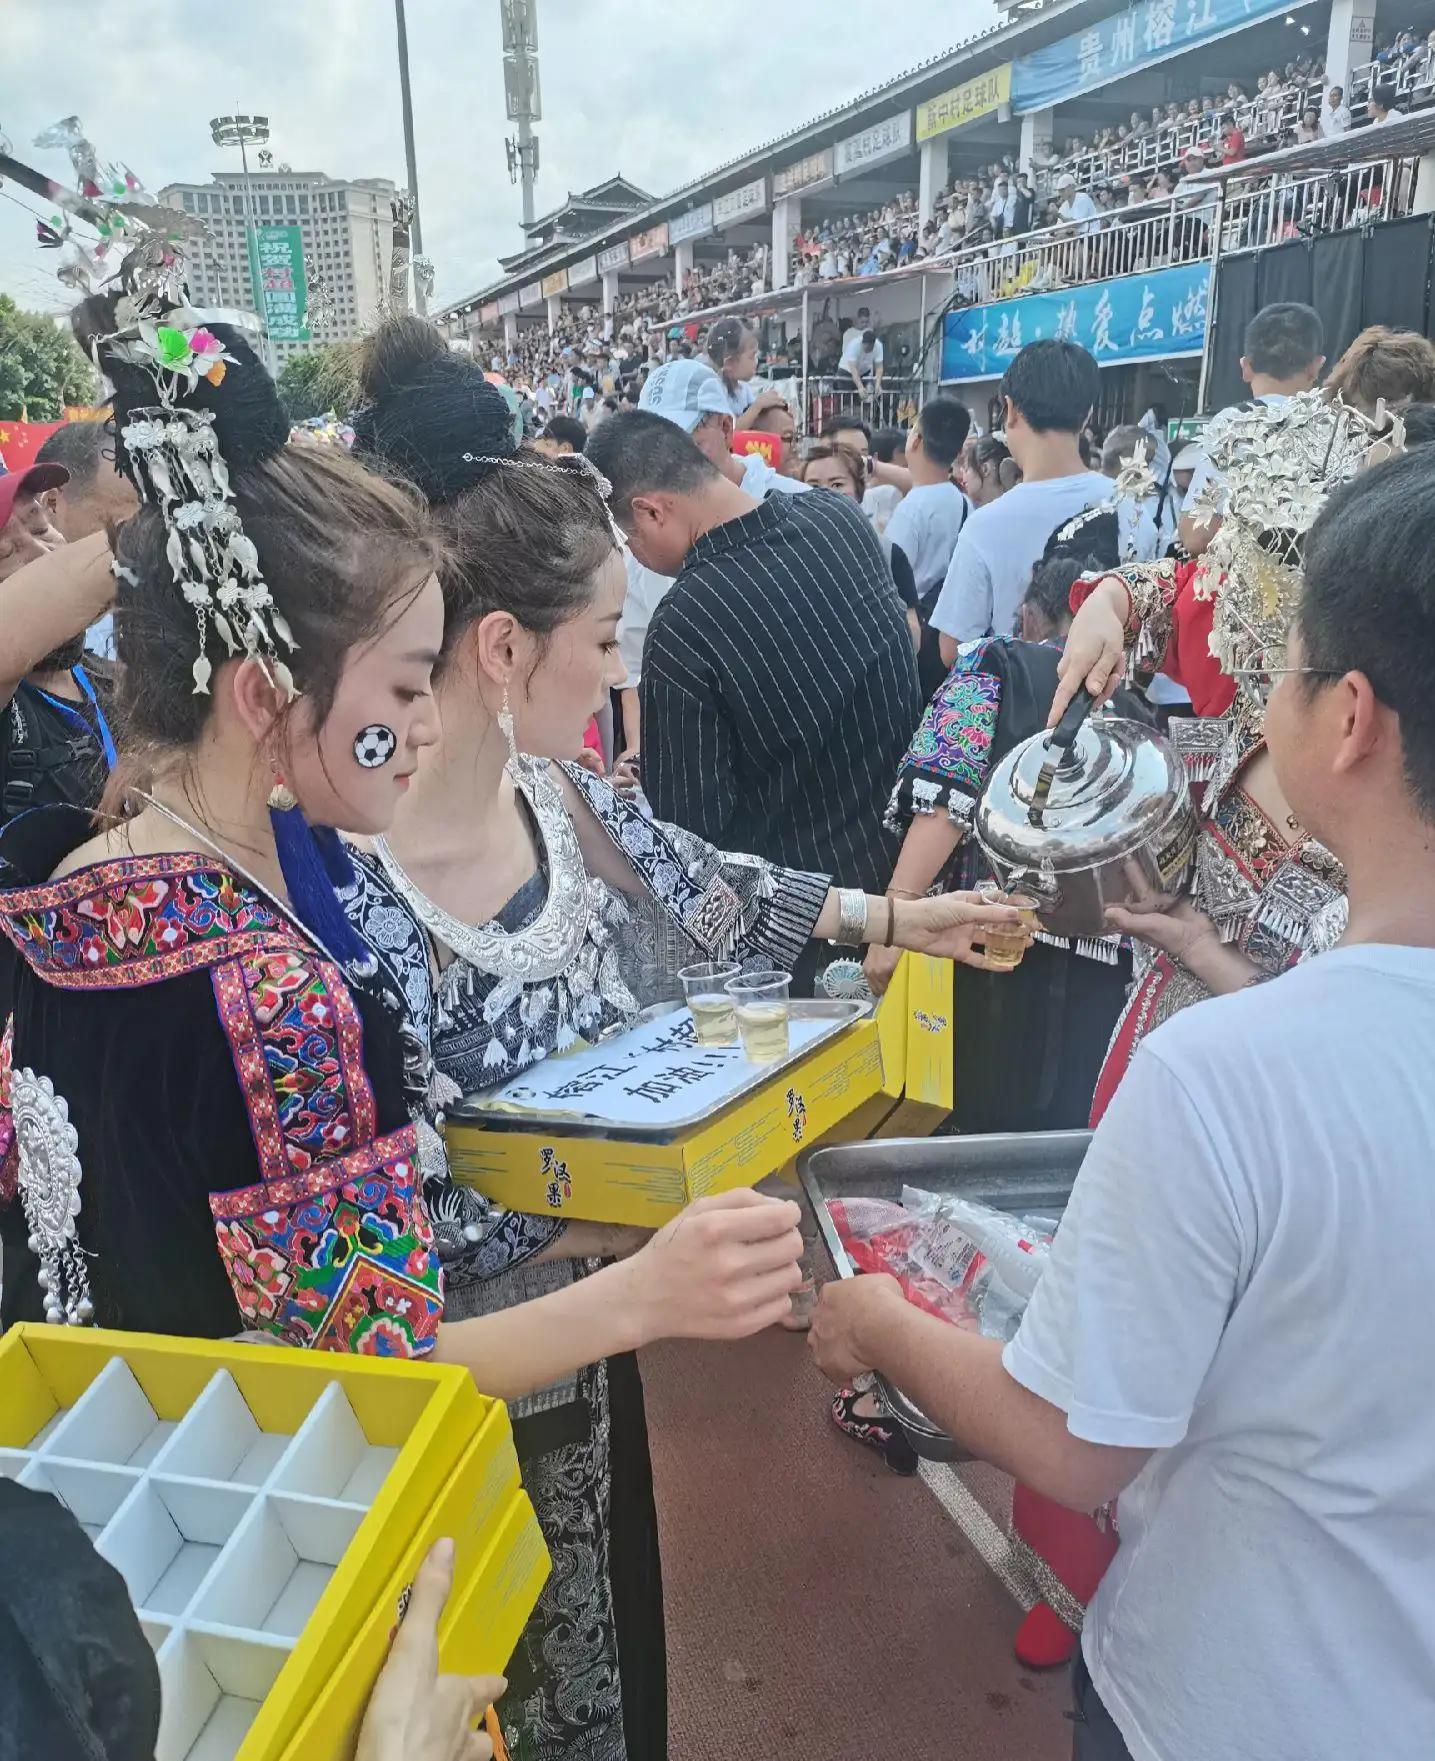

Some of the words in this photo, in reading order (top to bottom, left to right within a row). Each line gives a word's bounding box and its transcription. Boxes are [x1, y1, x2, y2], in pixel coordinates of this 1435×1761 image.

[1076, 0, 1250, 84] 贵州榕江
[785, 1087, 806, 1144] 罗汉果
[540, 1147, 572, 1209] 罗汉果
